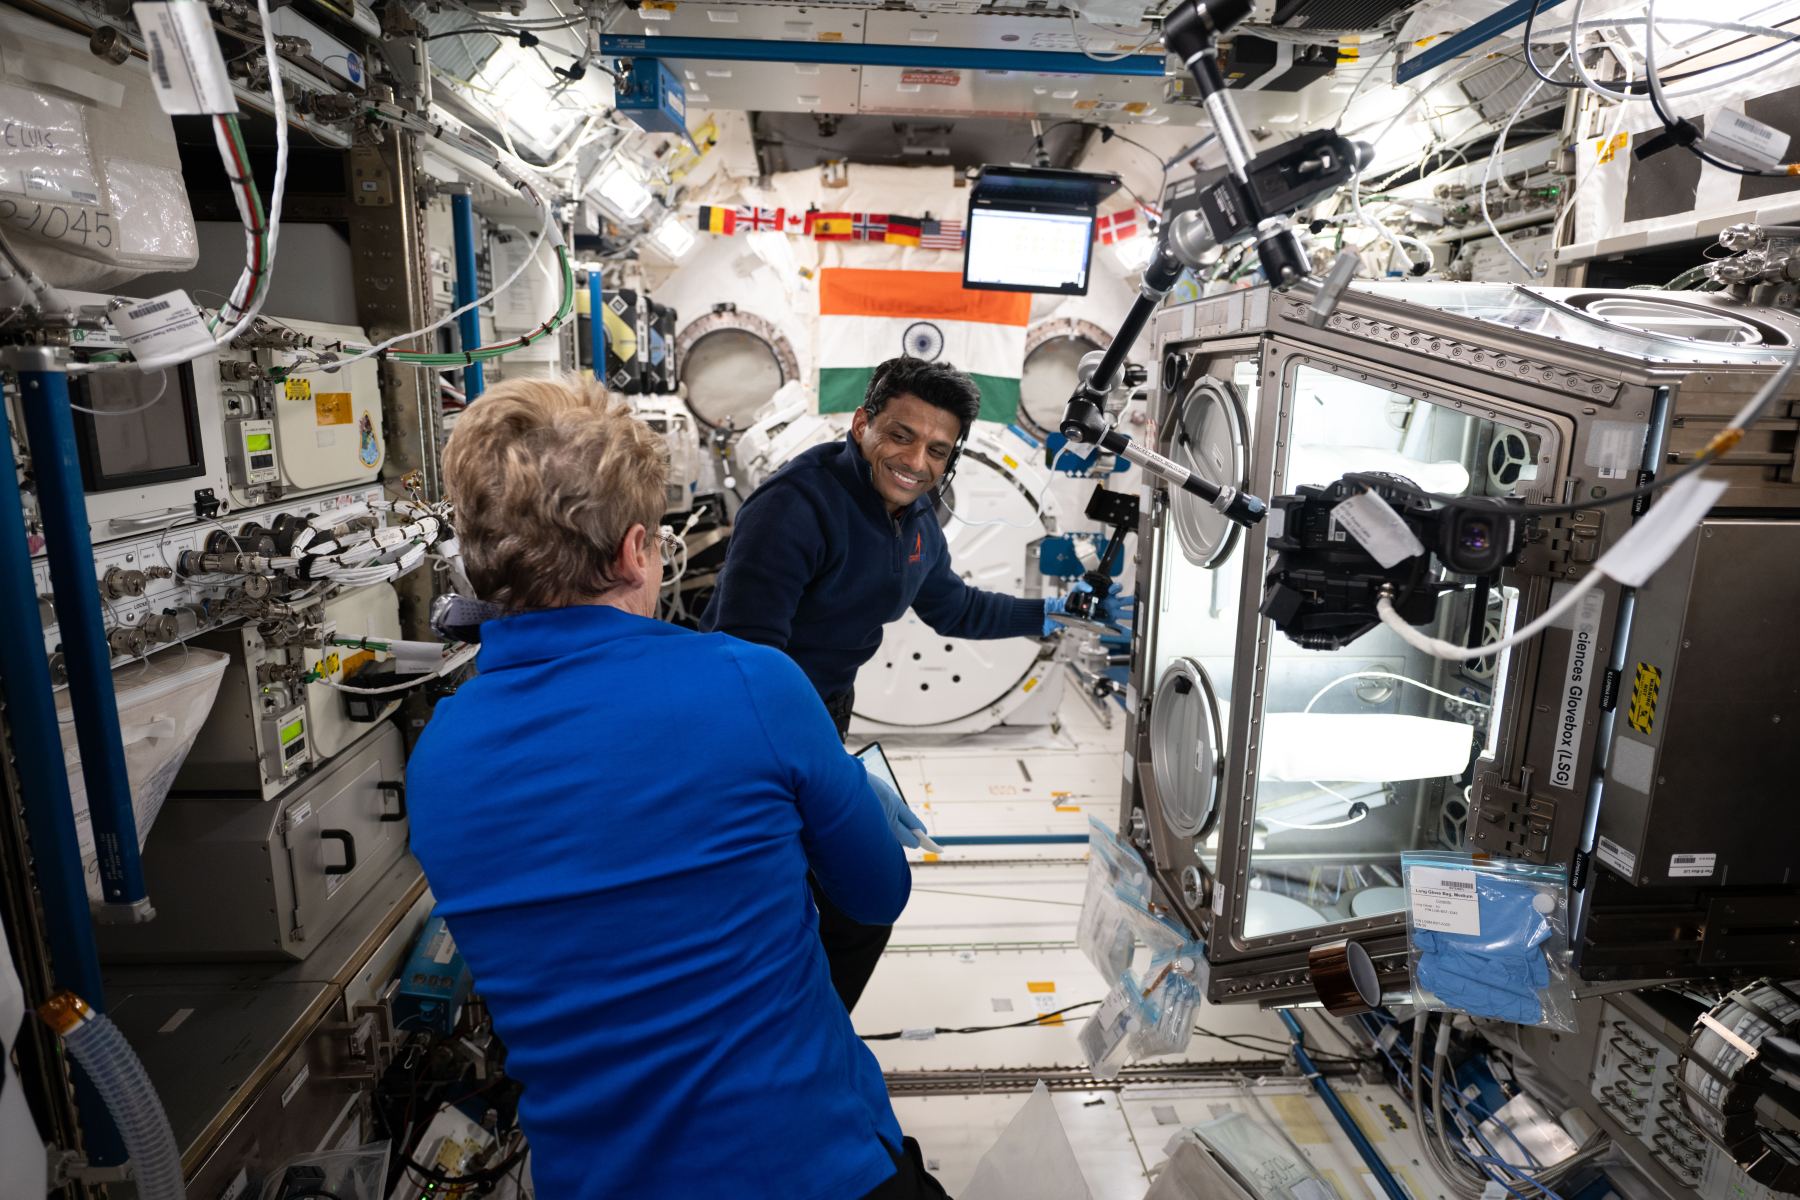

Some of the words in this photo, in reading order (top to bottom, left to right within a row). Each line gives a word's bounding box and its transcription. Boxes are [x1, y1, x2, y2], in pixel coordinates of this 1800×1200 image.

[1571, 622, 1593, 681] Sciences
[1561, 684, 1582, 746] Glovebox
[1645, 677, 1655, 707] WARNING
[1552, 748, 1573, 785] (LSG)
